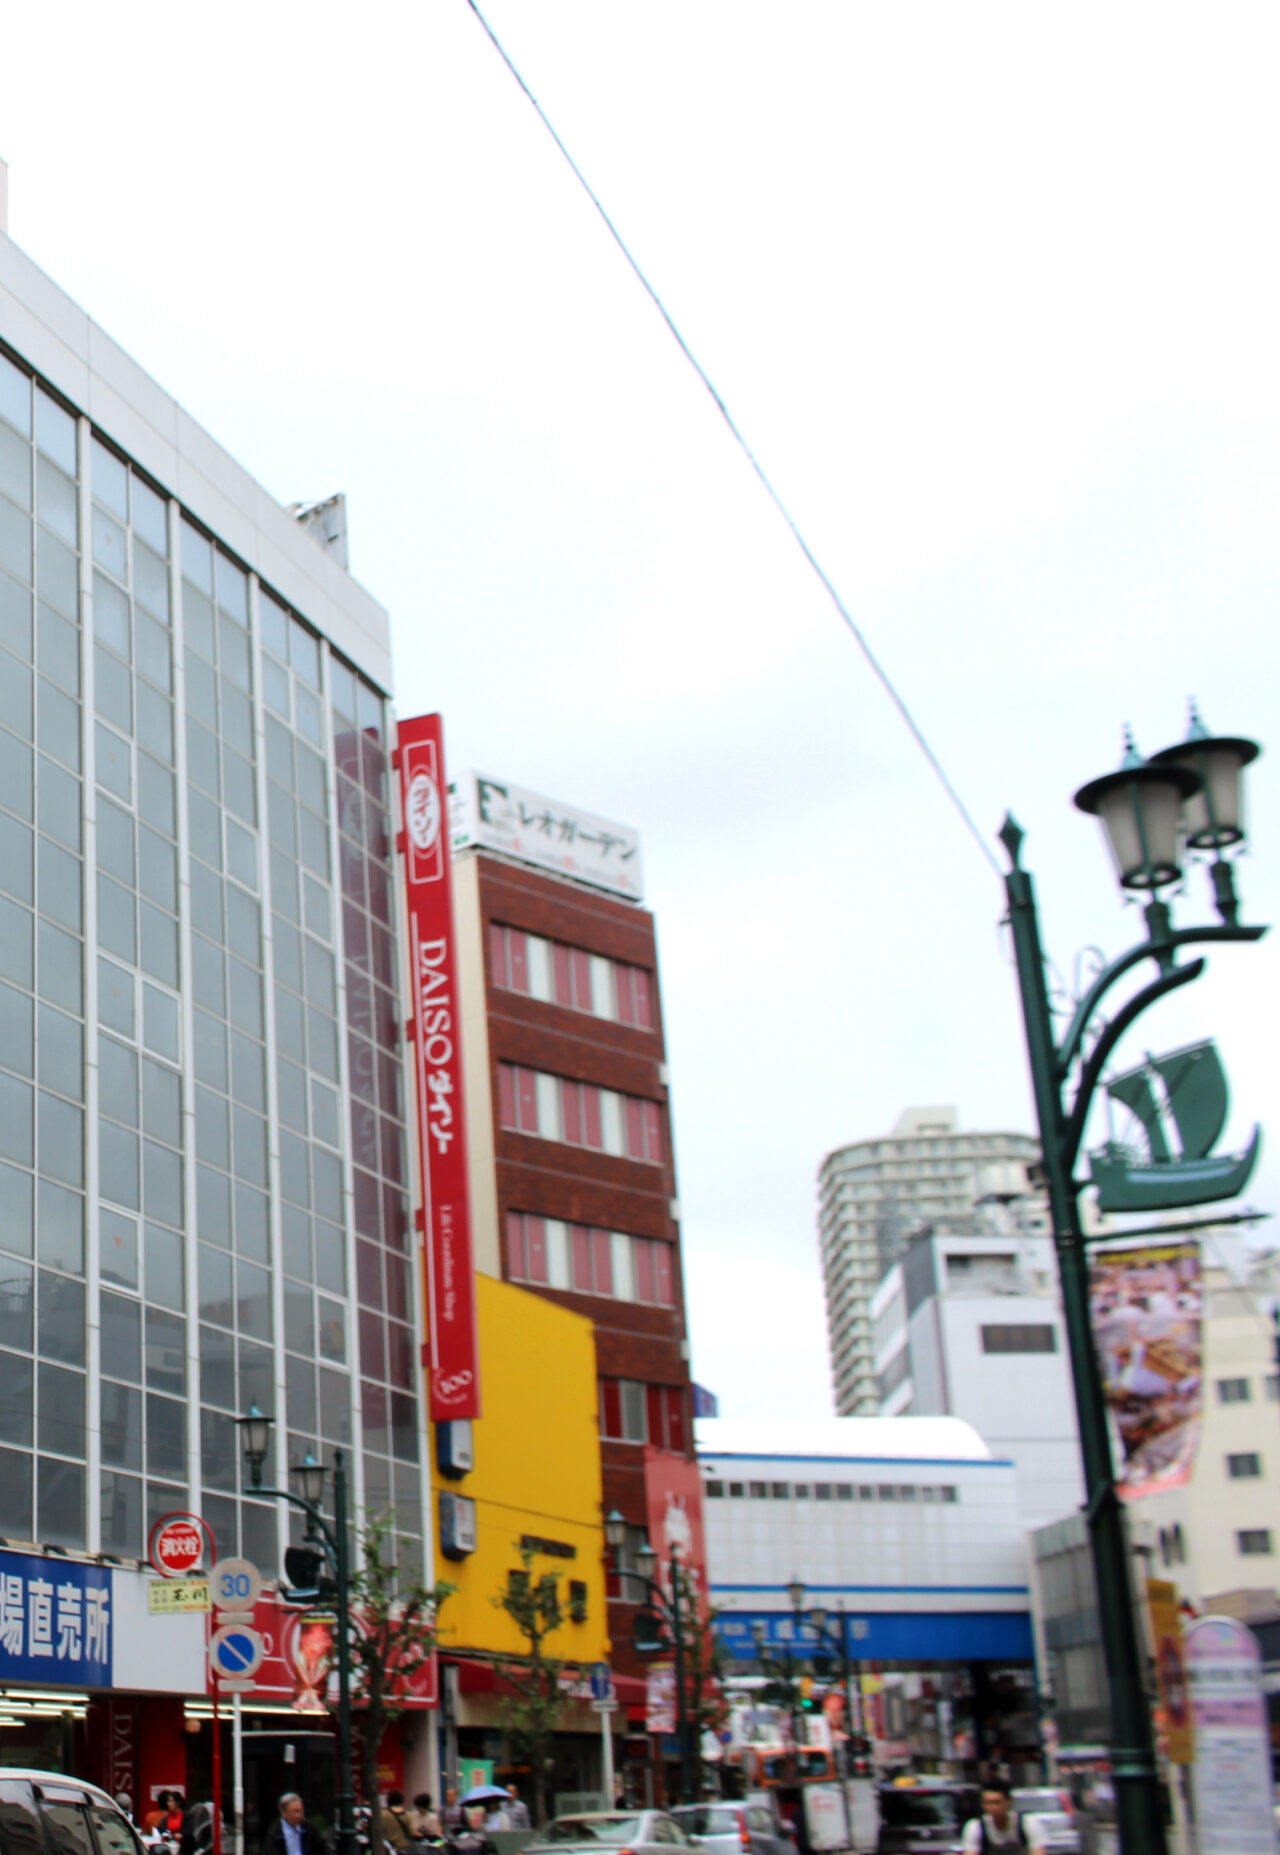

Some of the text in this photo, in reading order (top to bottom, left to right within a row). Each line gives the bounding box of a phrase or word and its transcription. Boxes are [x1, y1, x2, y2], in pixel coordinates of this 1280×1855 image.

[420, 937, 452, 1065] DAISO
[161, 1536, 197, 1556] 消火栓
[221, 1574, 250, 1597] 30
[114, 1714, 132, 1790] DAIS
